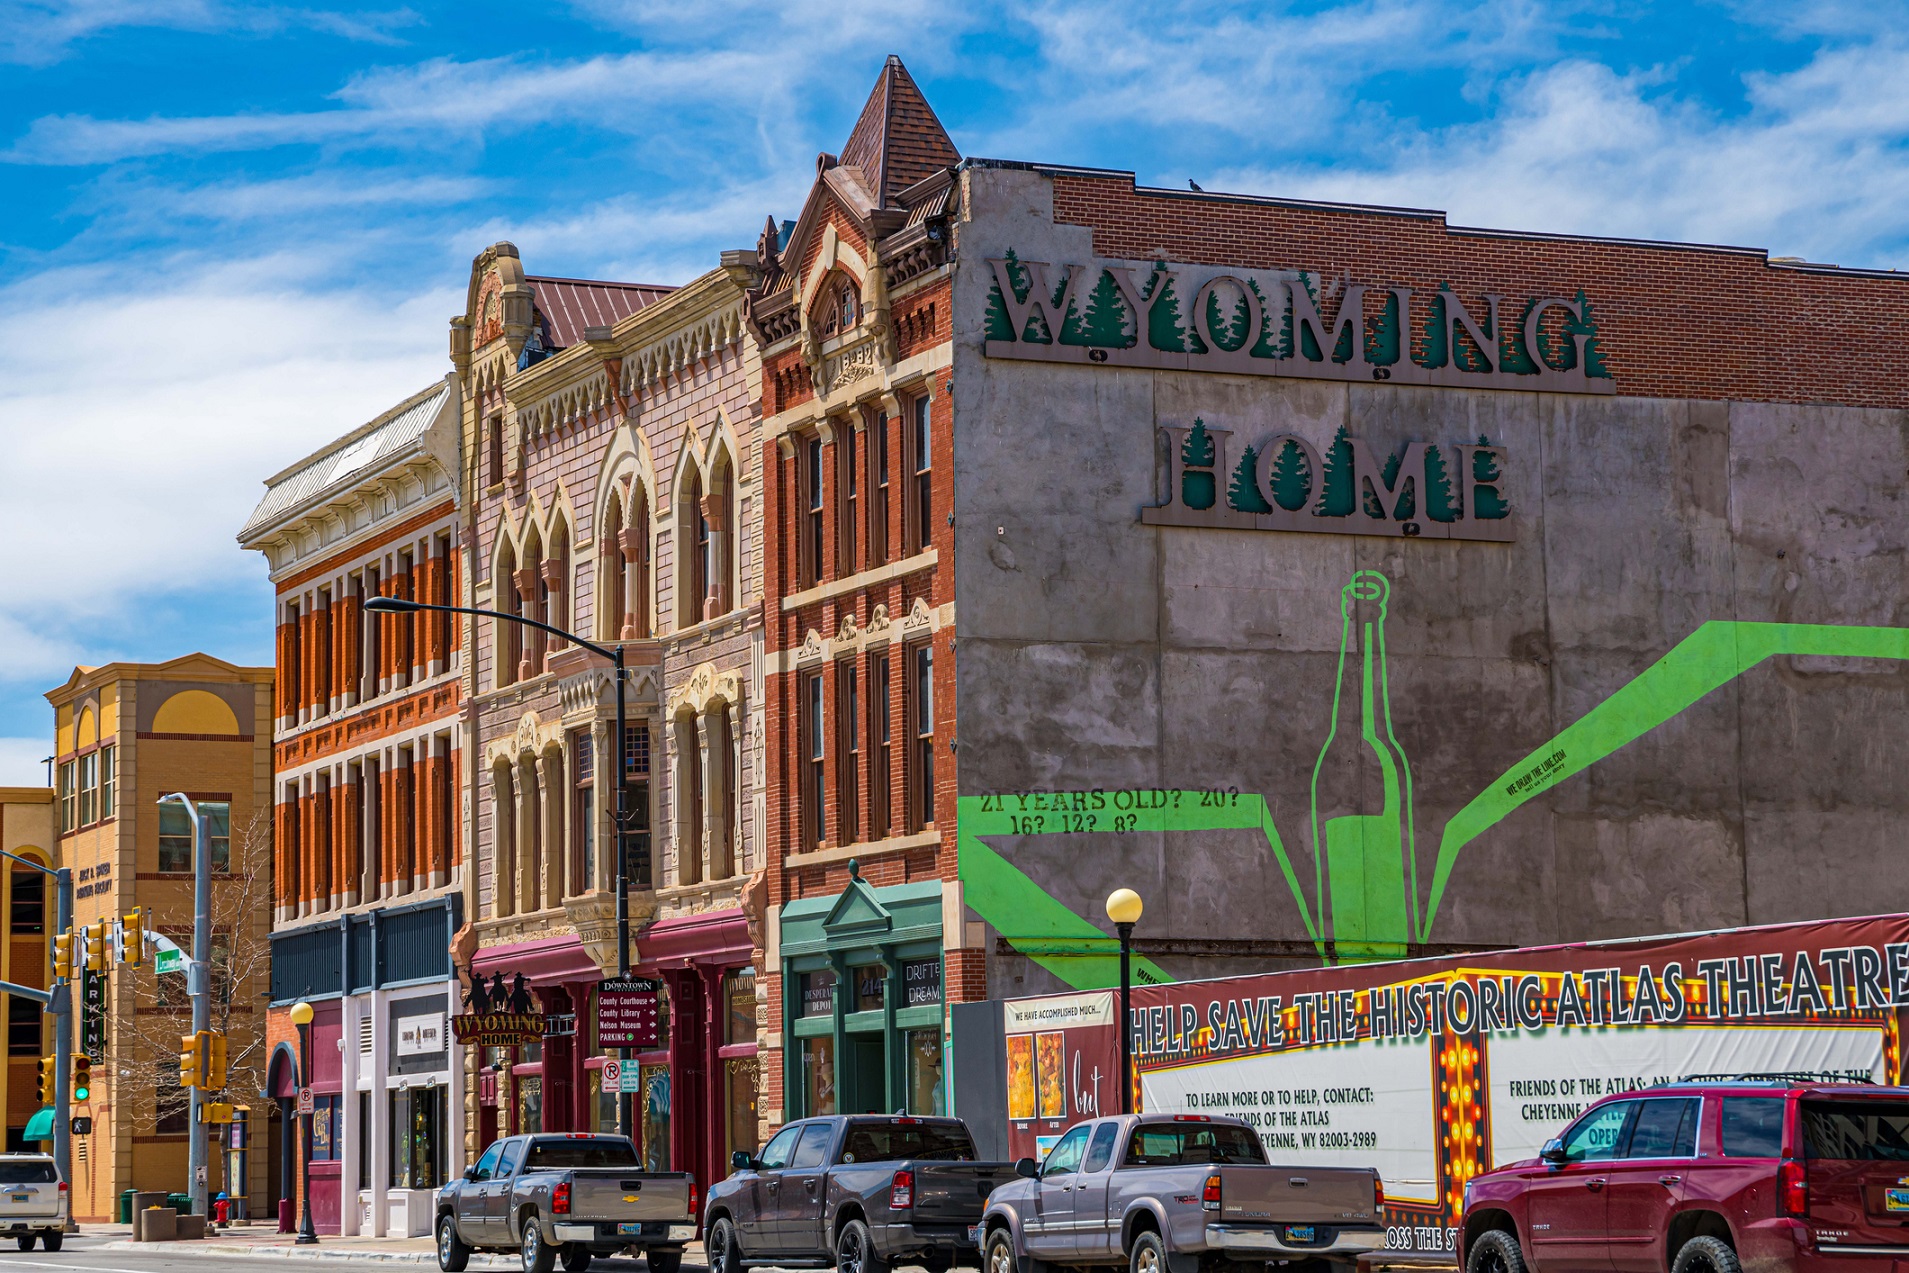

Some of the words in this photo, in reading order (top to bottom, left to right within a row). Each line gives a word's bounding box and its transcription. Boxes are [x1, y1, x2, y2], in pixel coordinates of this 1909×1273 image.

[985, 257, 1592, 374] WYOMING
[1160, 426, 1513, 522] HOME
[1506, 782, 1518, 797] WE
[1515, 773, 1533, 790] DRAW
[1531, 765, 1543, 778] THE
[1541, 748, 1567, 772] LINE.COM
[980, 790, 1004, 812] 21
[1013, 788, 1106, 812] YEARS
[1113, 788, 1182, 810] OLD?
[1199, 785, 1239, 808] 20?
[1010, 815, 1045, 836] 16?
[1062, 814, 1097, 834] 12?
[1114, 813, 1138, 835] 8?
[604, 982, 652, 990] DOWNTOWN
[862, 977, 884, 996] 214
[600, 997, 617, 1006] County
[620, 997, 648, 1005] Courthouse
[812, 1000, 831, 1011] DEPOT
[1129, 1003, 1198, 1055] HELP
[1208, 995, 1284, 1051] SAVE
[1293, 989, 1357, 1044] THE
[1368, 973, 1543, 1039] HISTORIC
[1555, 961, 1685, 1027] ATLAS
[1697, 942, 1909, 1019] THEATRE
[88, 975, 99, 1057] ARKING
[600, 1009, 618, 1018] County
[621, 1009, 640, 1018] Library
[1015, 1012, 1023, 1021] WE
[1024, 1010, 1037, 1021] HAVE
[1039, 1006, 1078, 1019] ACCOMPLISHED
[455, 1014, 545, 1035] WYOMING
[600, 1021, 617, 1029] Nelson
[621, 1021, 641, 1029] Museum
[481, 1033, 521, 1045] HOME
[600, 1033, 626, 1041] PARKING
[1073, 1049, 1104, 1118] but
[1510, 1080, 1556, 1097] FRIENDS
[1560, 1079, 1575, 1096] OF
[1579, 1078, 1601, 1095] THE
[1186, 1093, 1199, 1107] TO
[1201, 1092, 1229, 1107] LEARN
[1232, 1091, 1258, 1106] MORE
[1261, 1090, 1275, 1105] OR
[1277, 1090, 1291, 1104] TO
[1294, 1089, 1320, 1106] HELP,
[1323, 1087, 1374, 1103] CONTACT:
[1265, 1112, 1277, 1126] OF
[1279, 1111, 1297, 1126] THE
[1300, 1111, 1330, 1126] ATLAS
[1521, 1103, 1581, 1121] CHEYENNE
[1260, 1133, 1298, 1150] EYENNE,
[1302, 1132, 1316, 1147] WY
[1319, 1131, 1377, 1148] 82003-2989
[1384, 1225, 1413, 1250] OSS
[1414, 1227, 1443, 1251] THE
